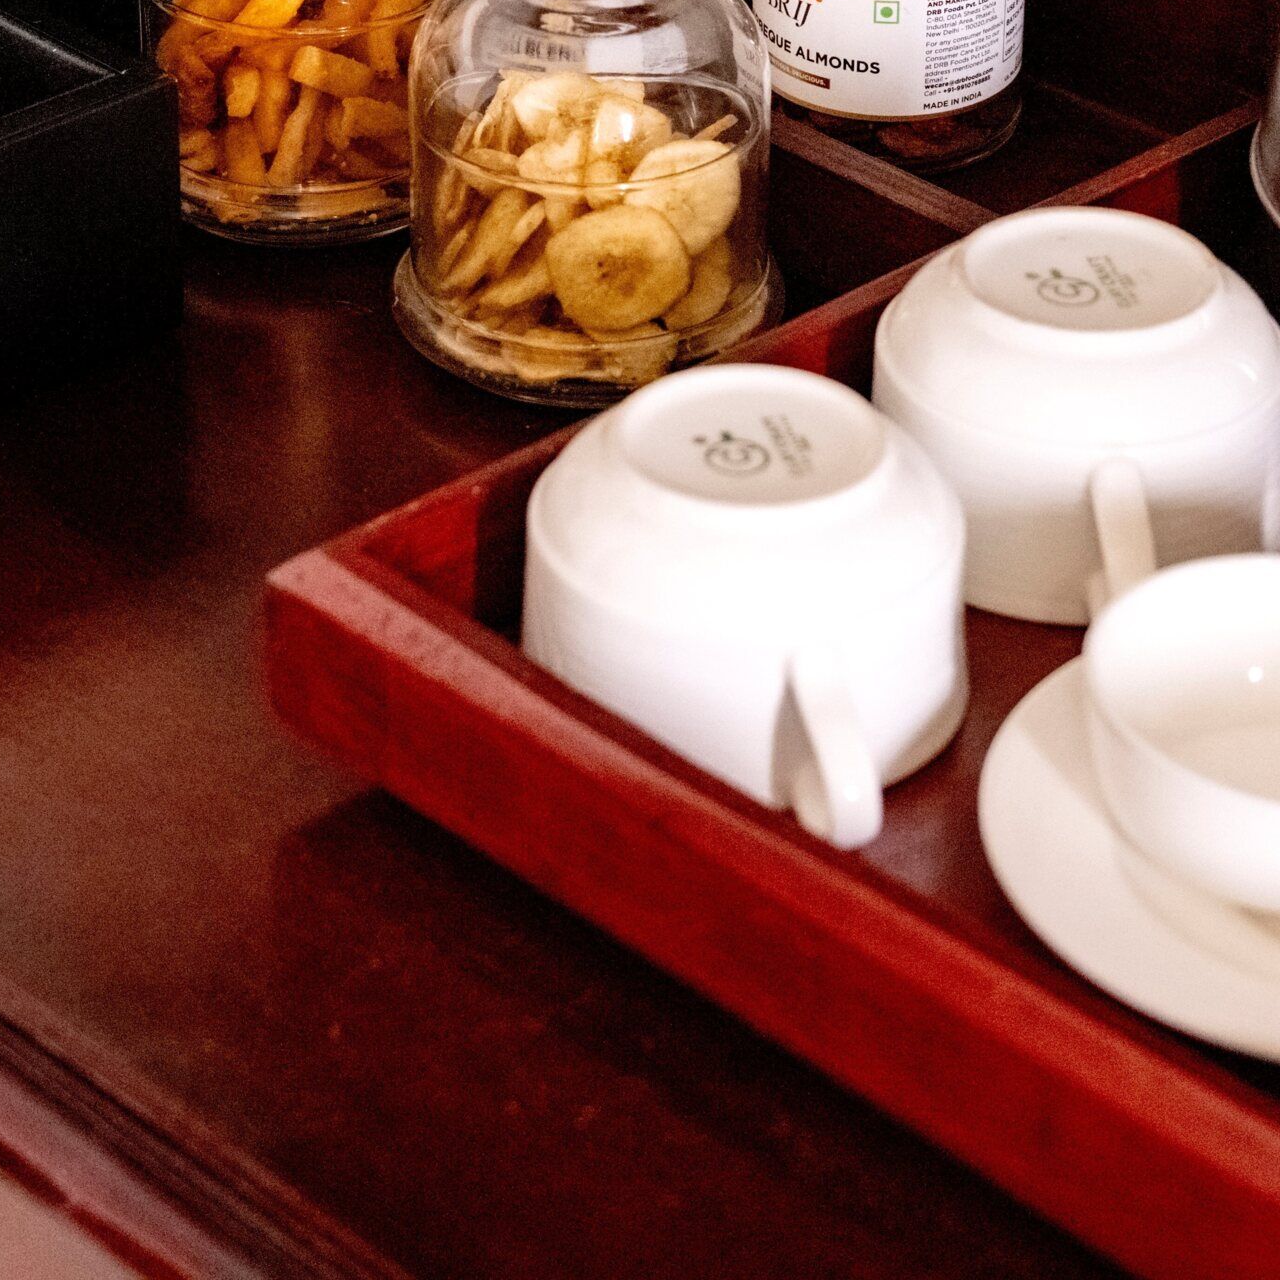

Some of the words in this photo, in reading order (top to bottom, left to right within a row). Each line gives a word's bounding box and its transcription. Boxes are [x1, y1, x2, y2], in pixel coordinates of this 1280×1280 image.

[796, 46, 880, 74] ALMONDS
[923, 100, 948, 110] MADE
[962, 91, 982, 102] INDIA
